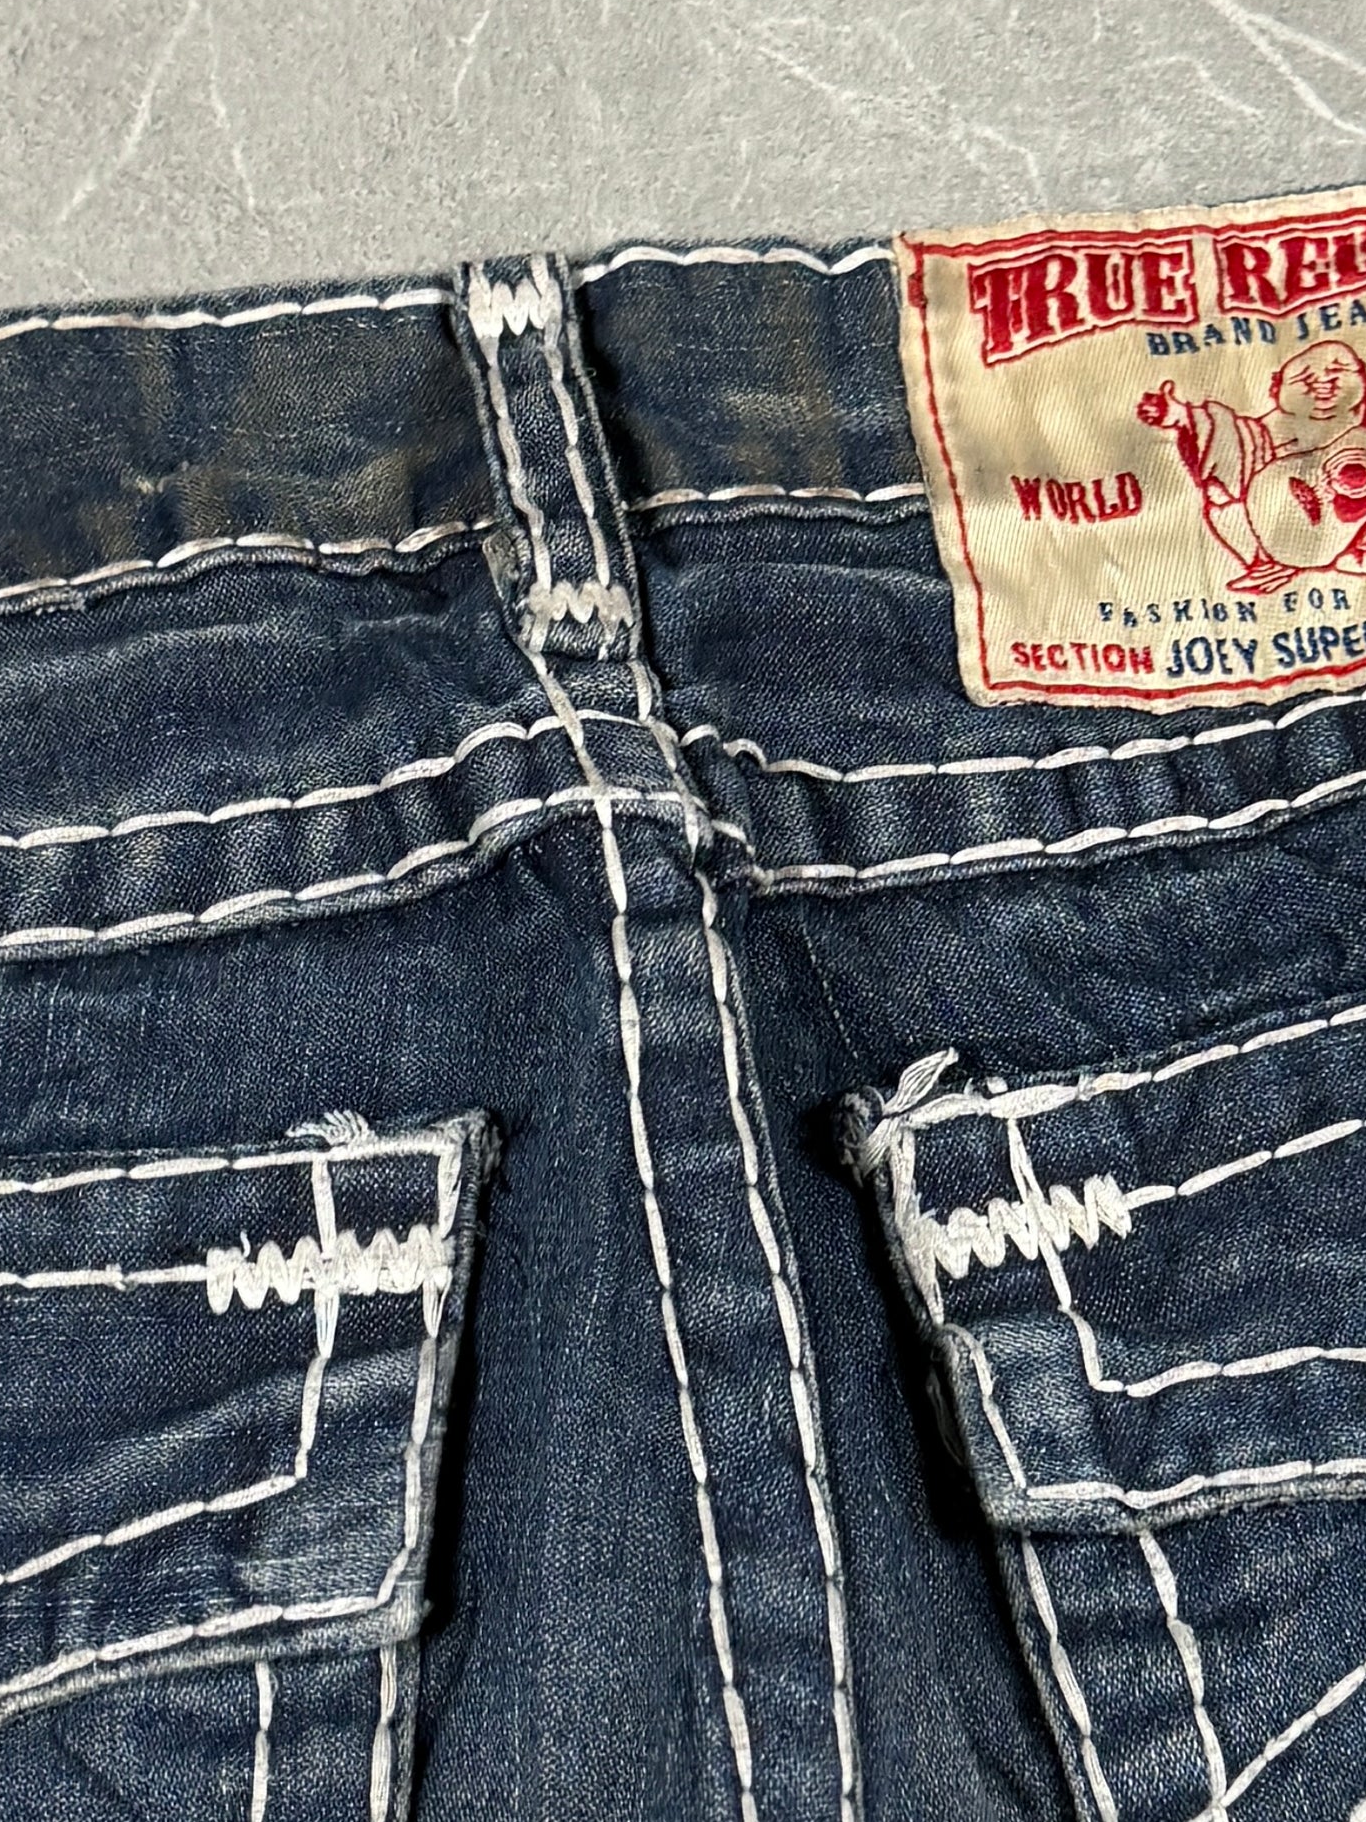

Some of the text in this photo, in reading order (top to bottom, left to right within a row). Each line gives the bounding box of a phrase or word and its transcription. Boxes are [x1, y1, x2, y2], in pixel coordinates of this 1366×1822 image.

[968, 238, 1198, 366] TRUE
[1147, 315, 1277, 356] BRAND
[1010, 471, 1142, 524] WORLD
[1099, 598, 1257, 627] FASHION
[1283, 587, 1351, 613] FOR
[1011, 641, 1155, 675] SECTION
[1166, 635, 1258, 678] JOEY
